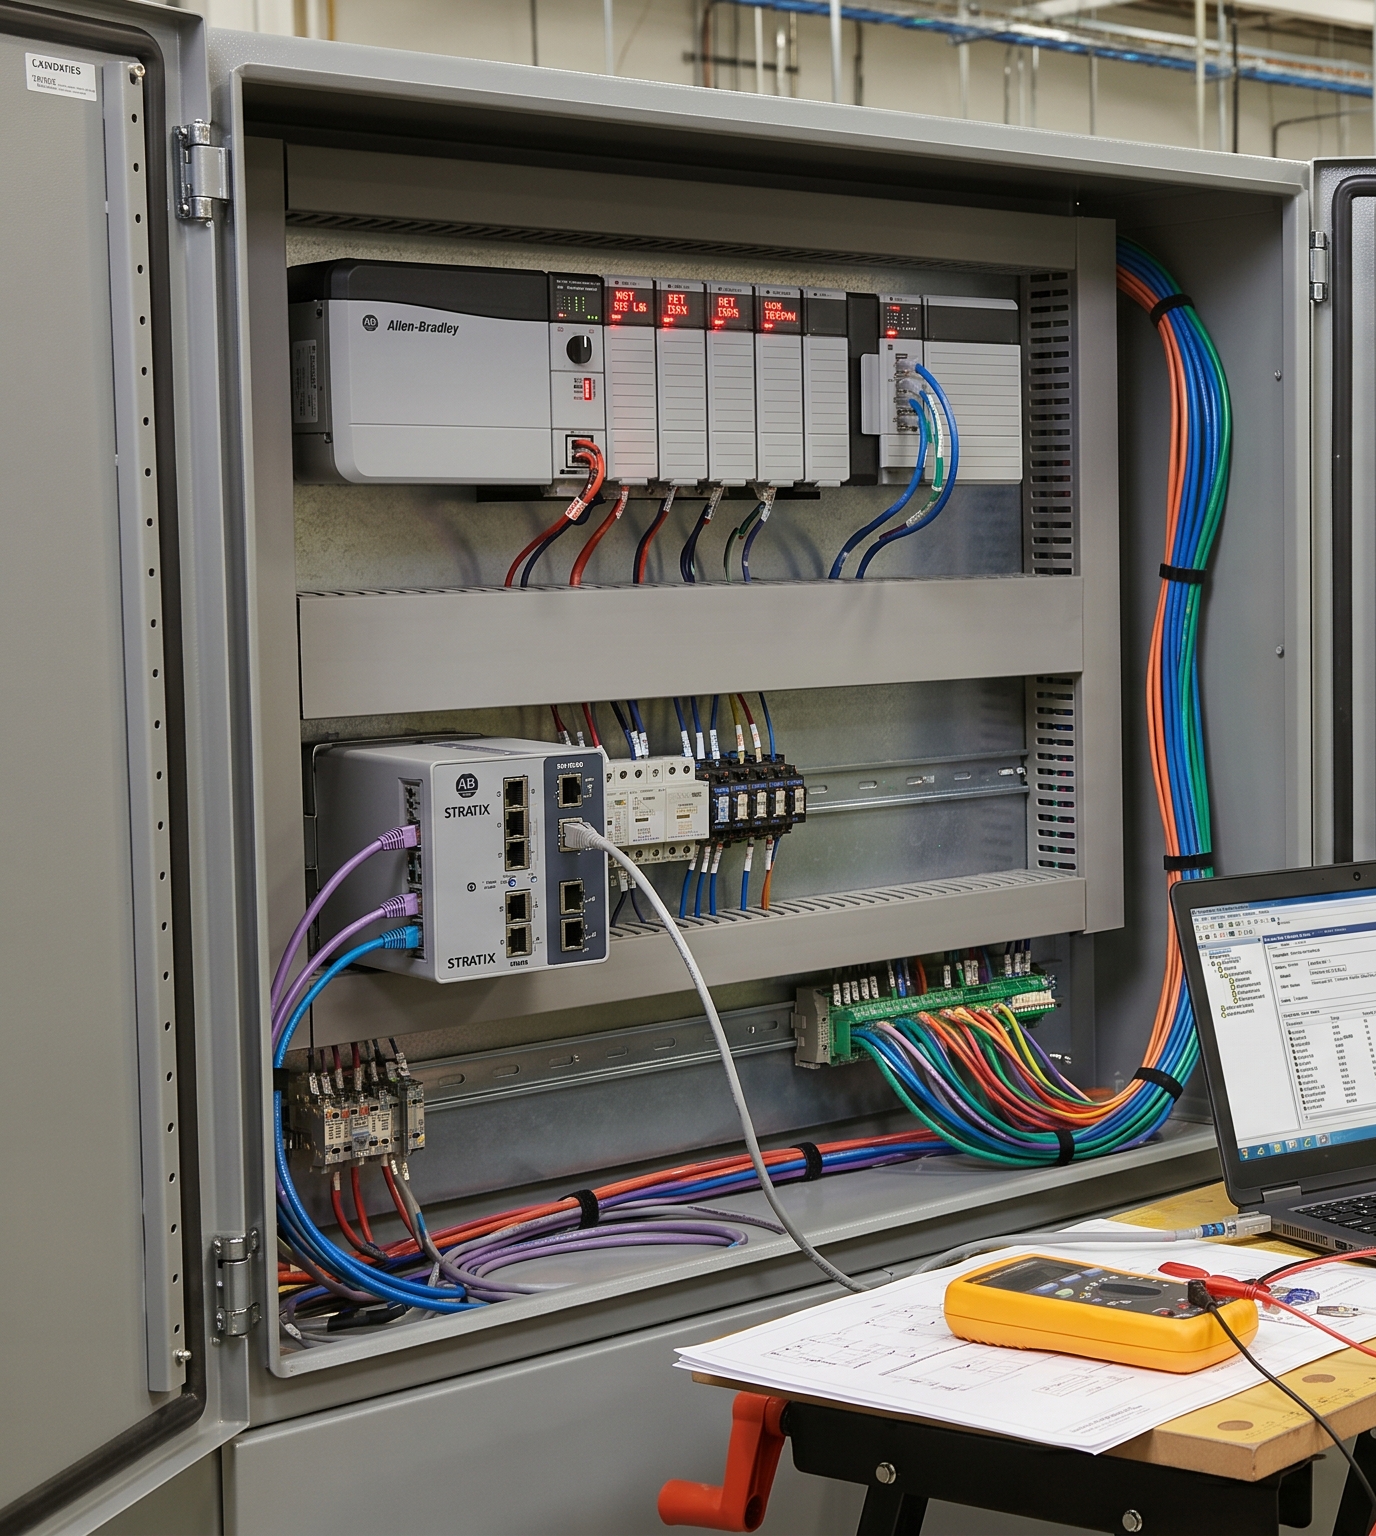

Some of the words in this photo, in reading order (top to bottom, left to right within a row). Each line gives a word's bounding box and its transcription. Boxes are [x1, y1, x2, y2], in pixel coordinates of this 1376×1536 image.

[387, 319, 460, 337] Allen-Bradley
[457, 778, 476, 790] AB
[444, 803, 491, 819] STRATIX
[447, 952, 497, 969] STRATIX
